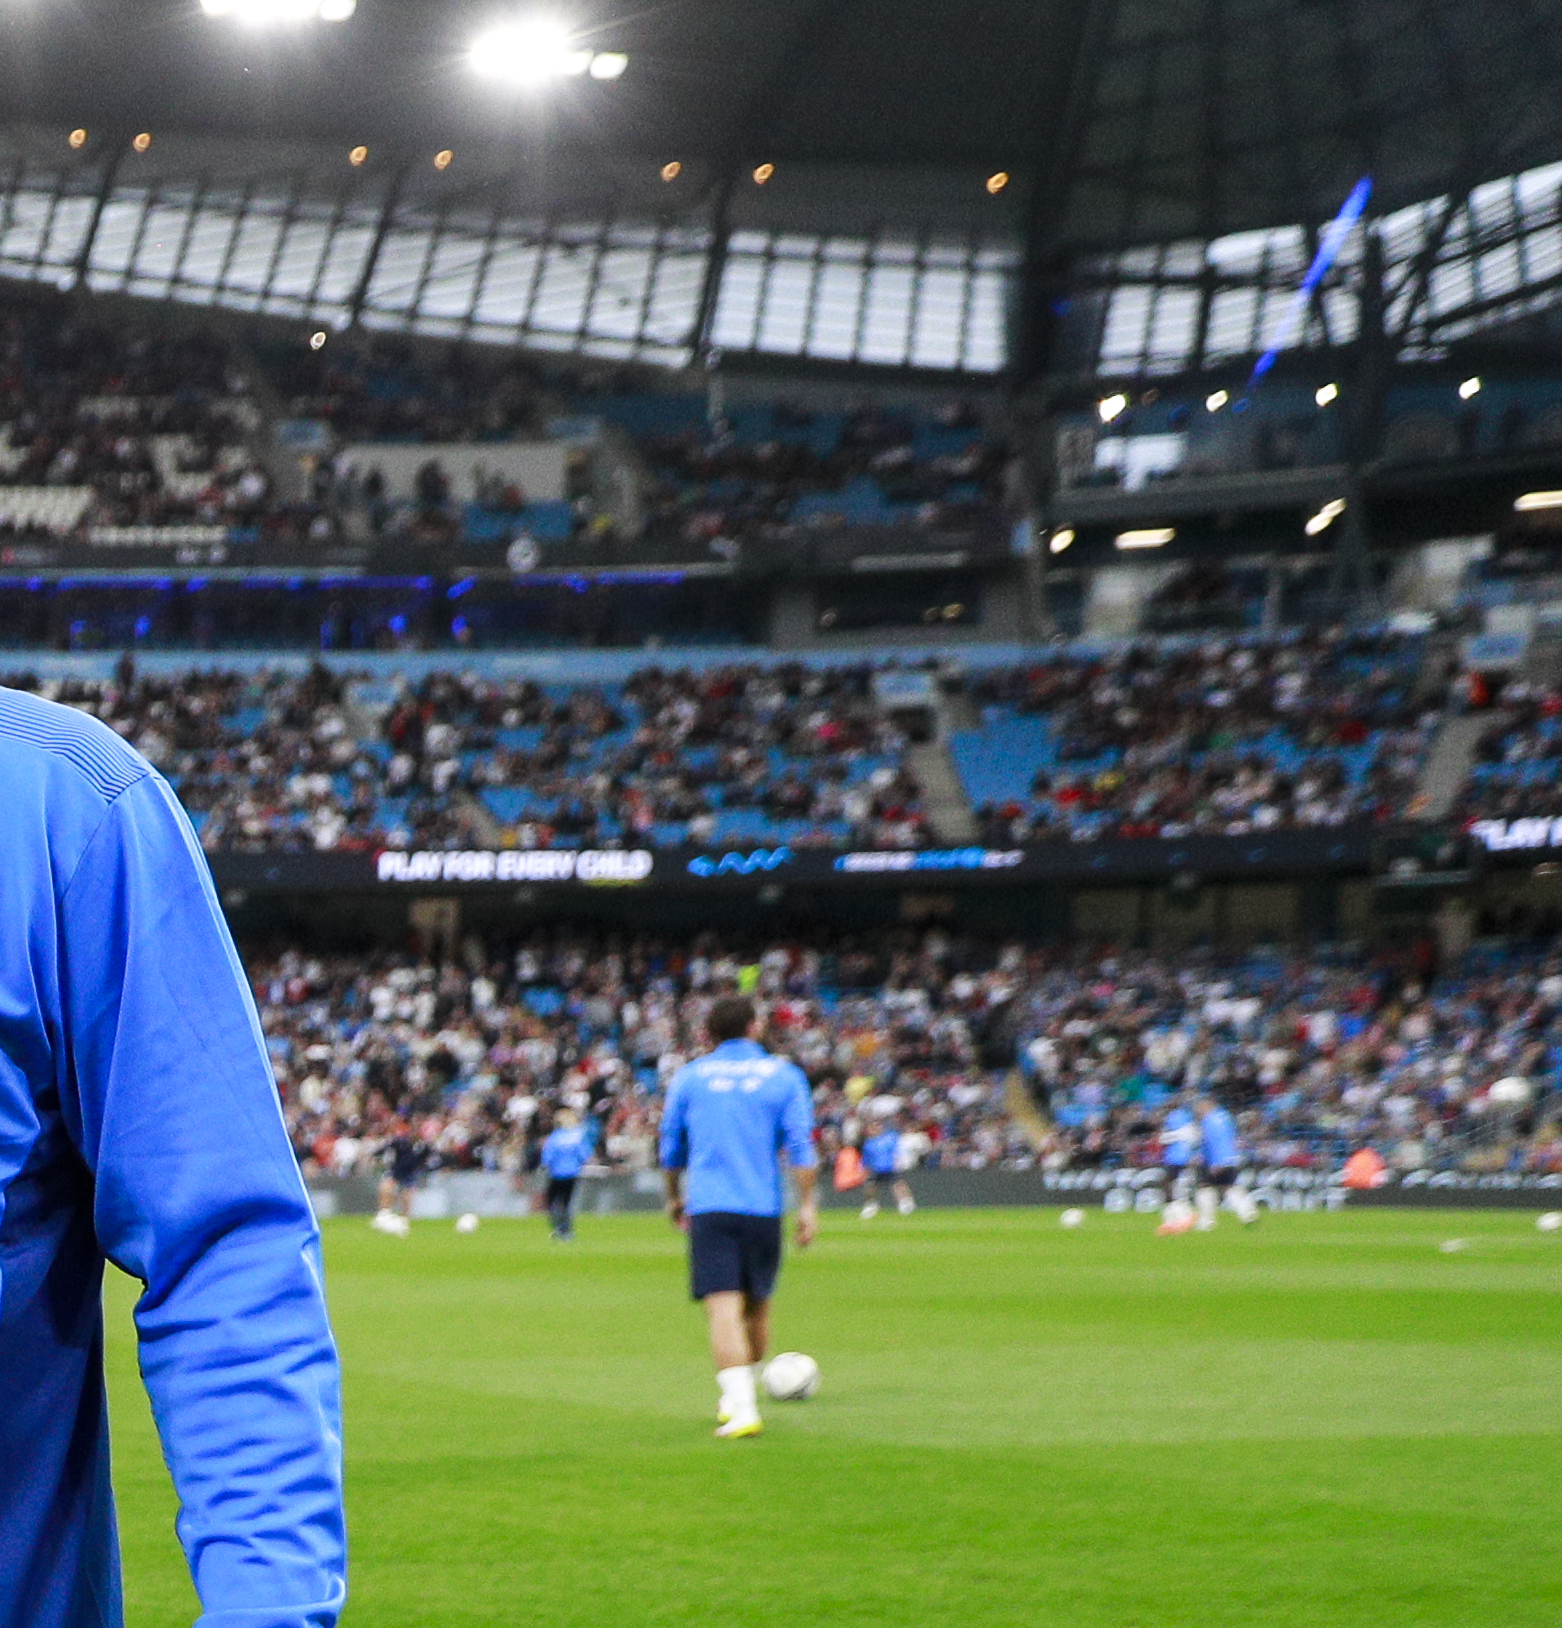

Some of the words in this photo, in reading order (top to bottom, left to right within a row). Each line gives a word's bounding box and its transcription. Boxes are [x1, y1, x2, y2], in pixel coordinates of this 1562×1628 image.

[378, 850, 443, 881] PLAY
[443, 850, 495, 881] FOR
[496, 850, 575, 881] EVERY
[576, 849, 653, 880] CHILD
